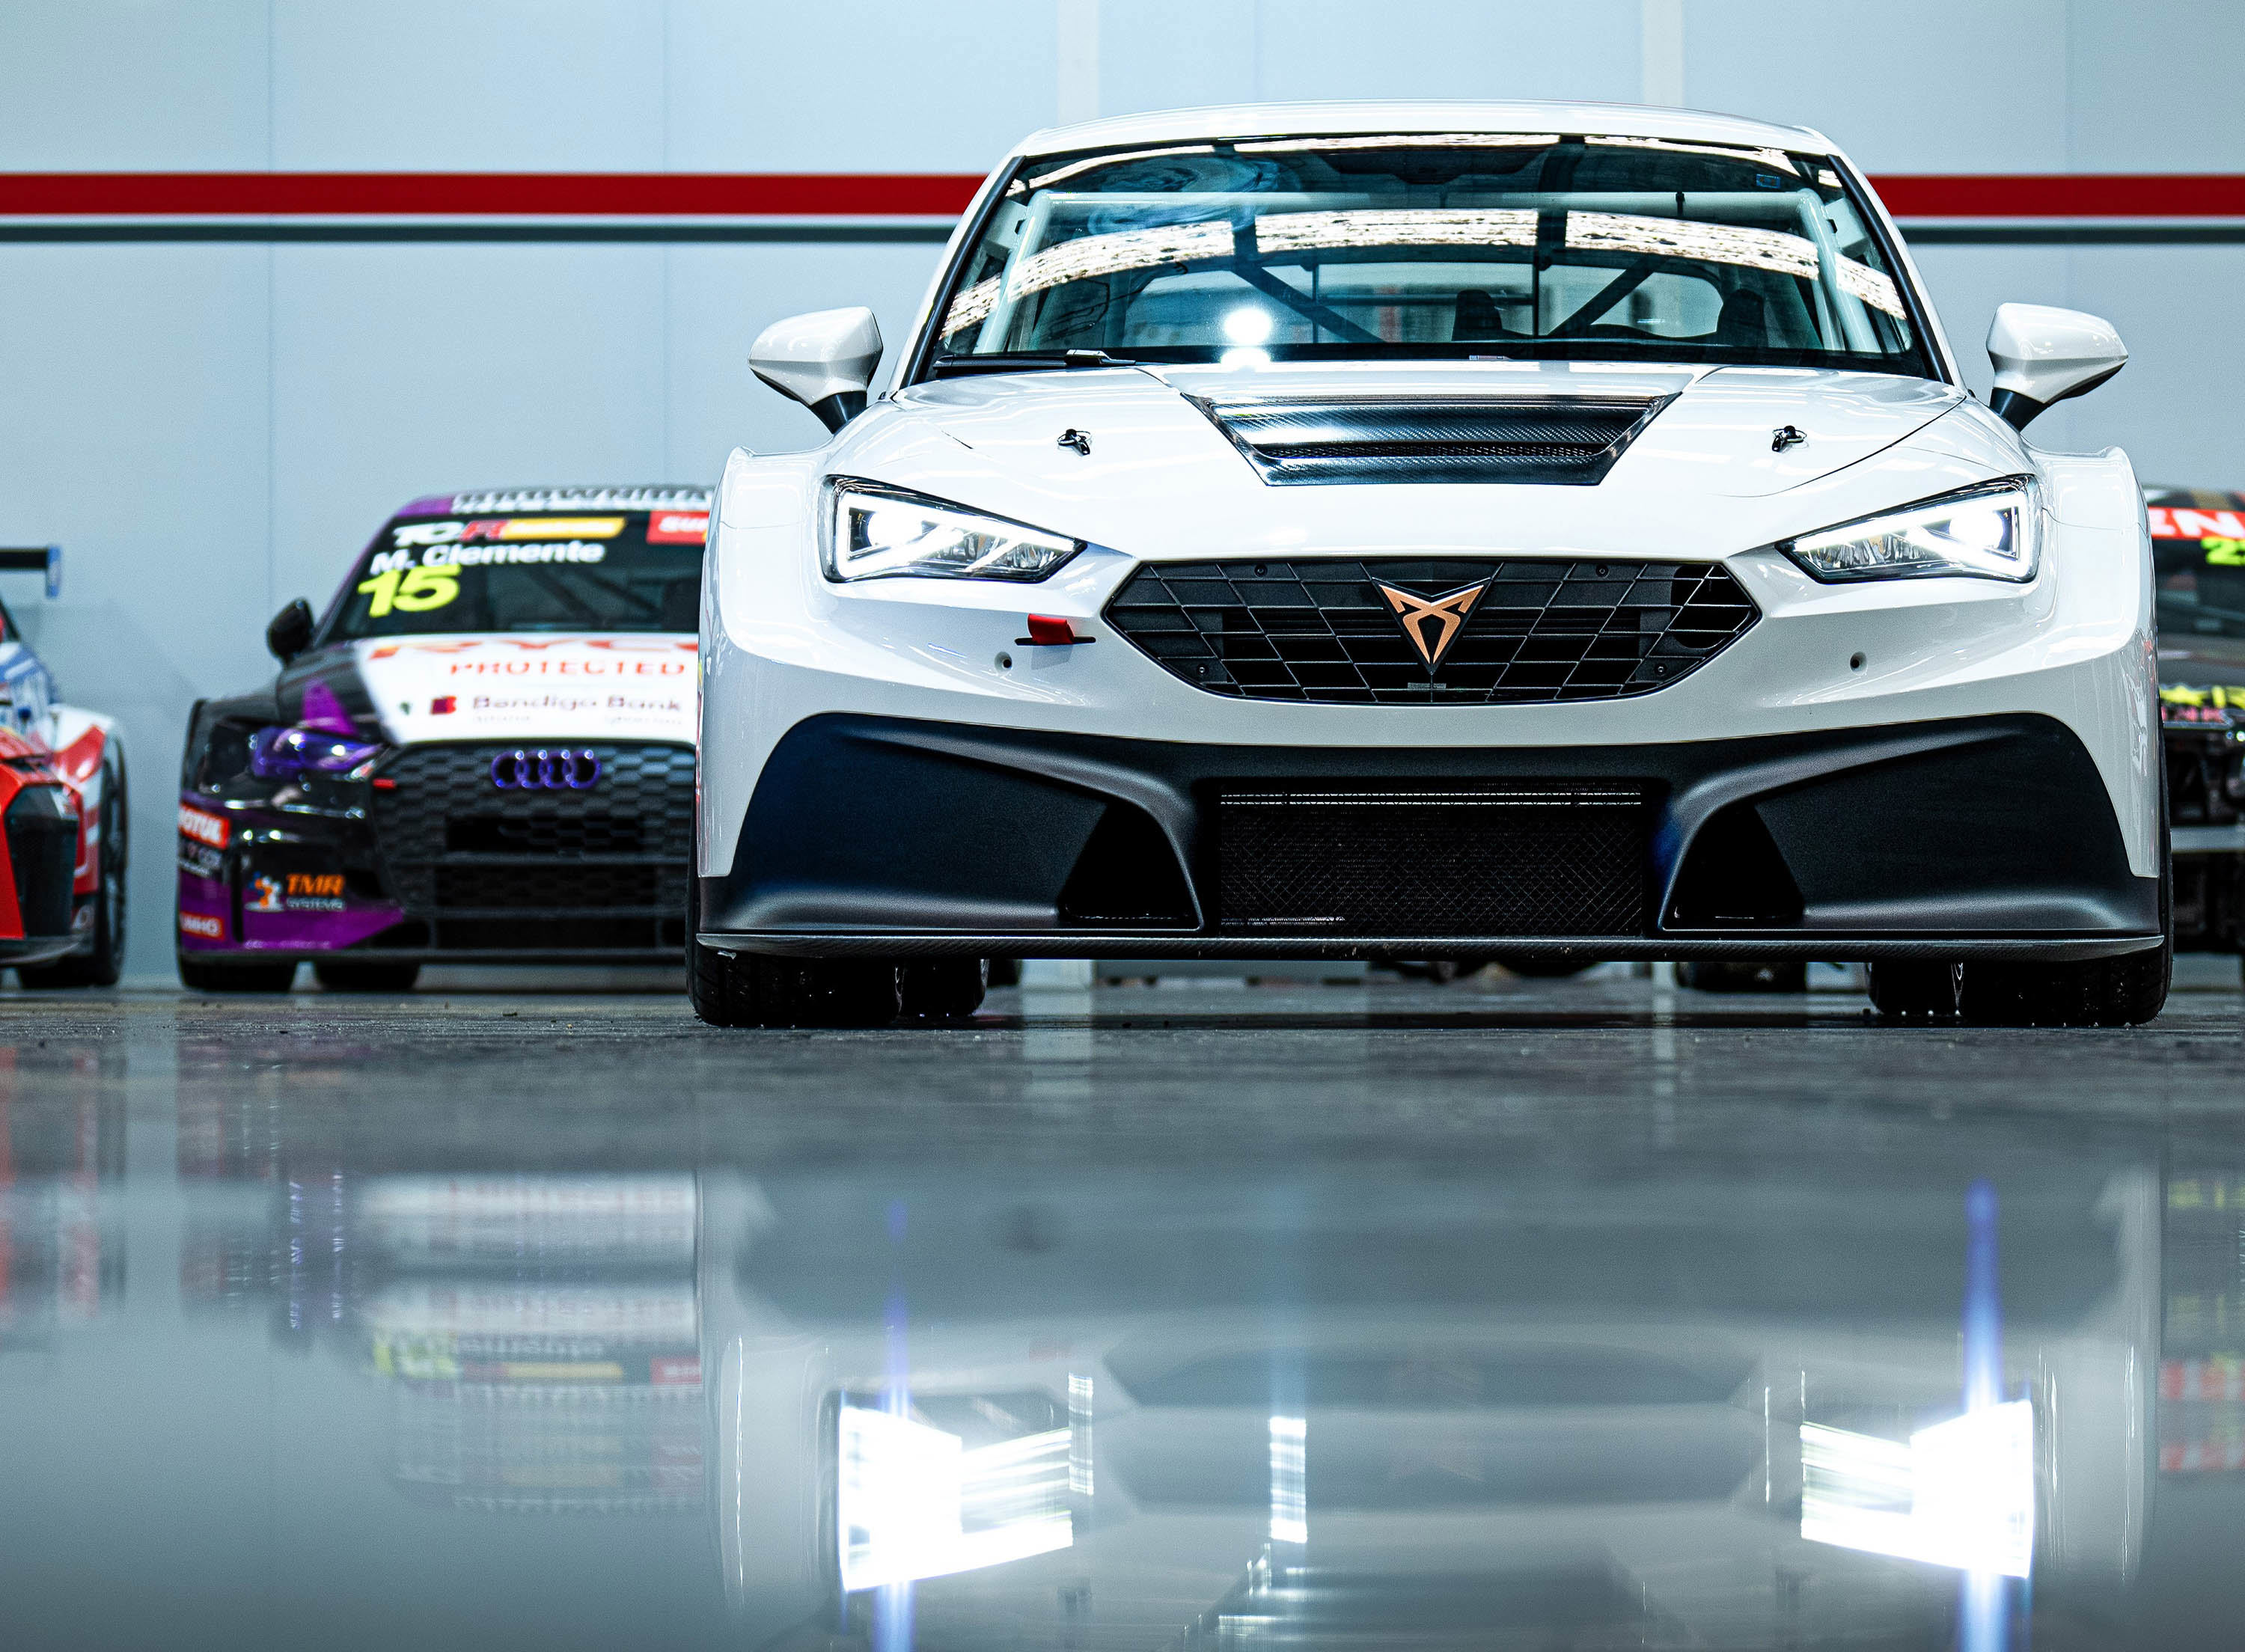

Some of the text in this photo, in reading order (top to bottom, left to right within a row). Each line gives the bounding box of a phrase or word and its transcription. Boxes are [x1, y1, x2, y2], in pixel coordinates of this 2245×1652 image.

[370, 540, 605, 575] M. Clemente
[2201, 536, 2245, 565] 2
[357, 563, 462, 618] 15
[450, 661, 685, 675] PROTECTED
[473, 696, 681, 711] Bendigo Bank
[287, 874, 346, 896] TMR
